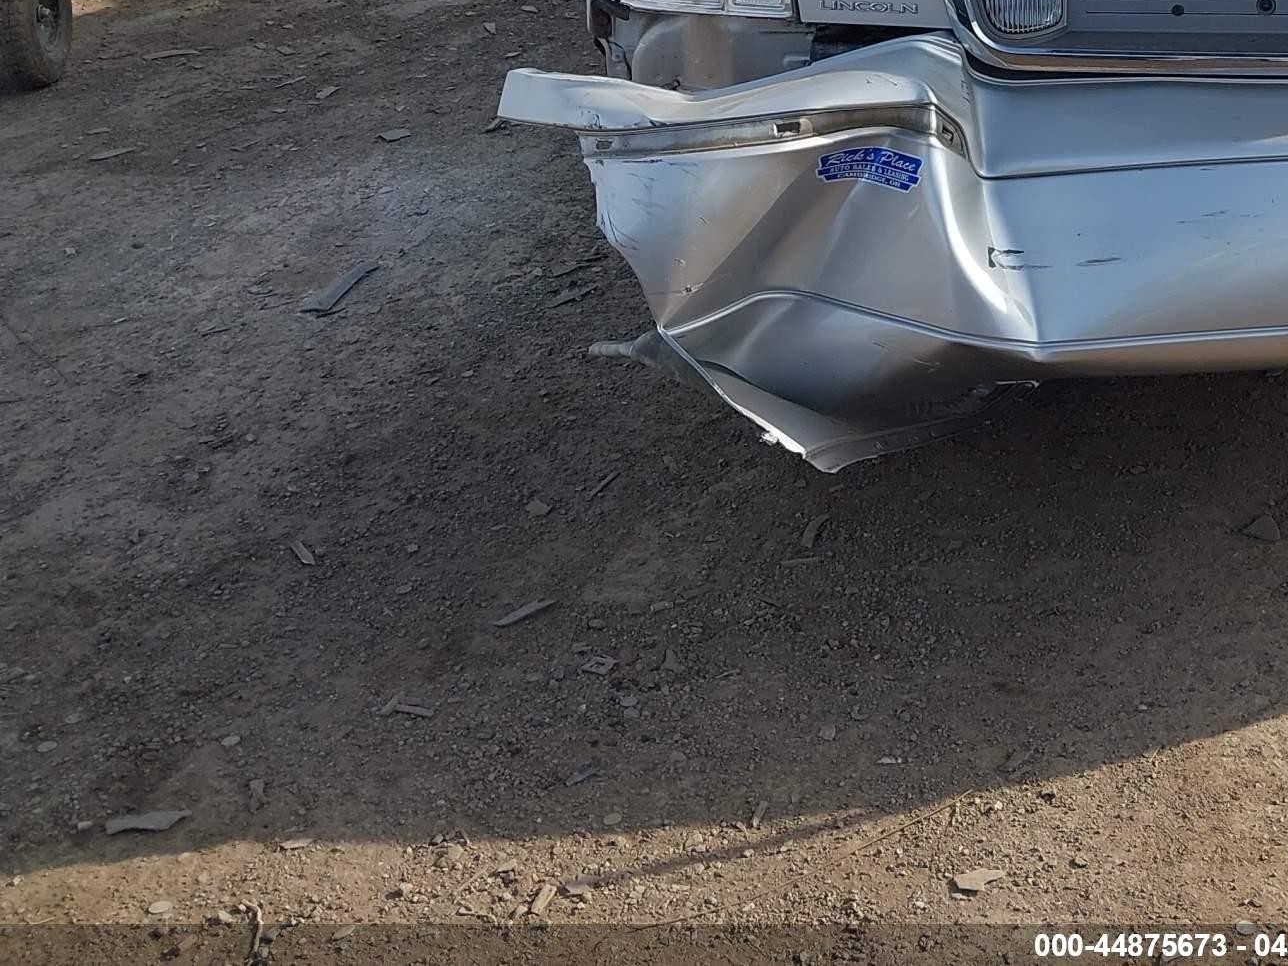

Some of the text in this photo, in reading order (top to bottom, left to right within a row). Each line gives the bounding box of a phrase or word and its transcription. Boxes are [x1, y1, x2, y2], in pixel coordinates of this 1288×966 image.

[818, 0, 919, 15] LINCOLN
[826, 149, 916, 171] Rick's Place
[829, 164, 909, 181] AUTO SALES & LEASING
